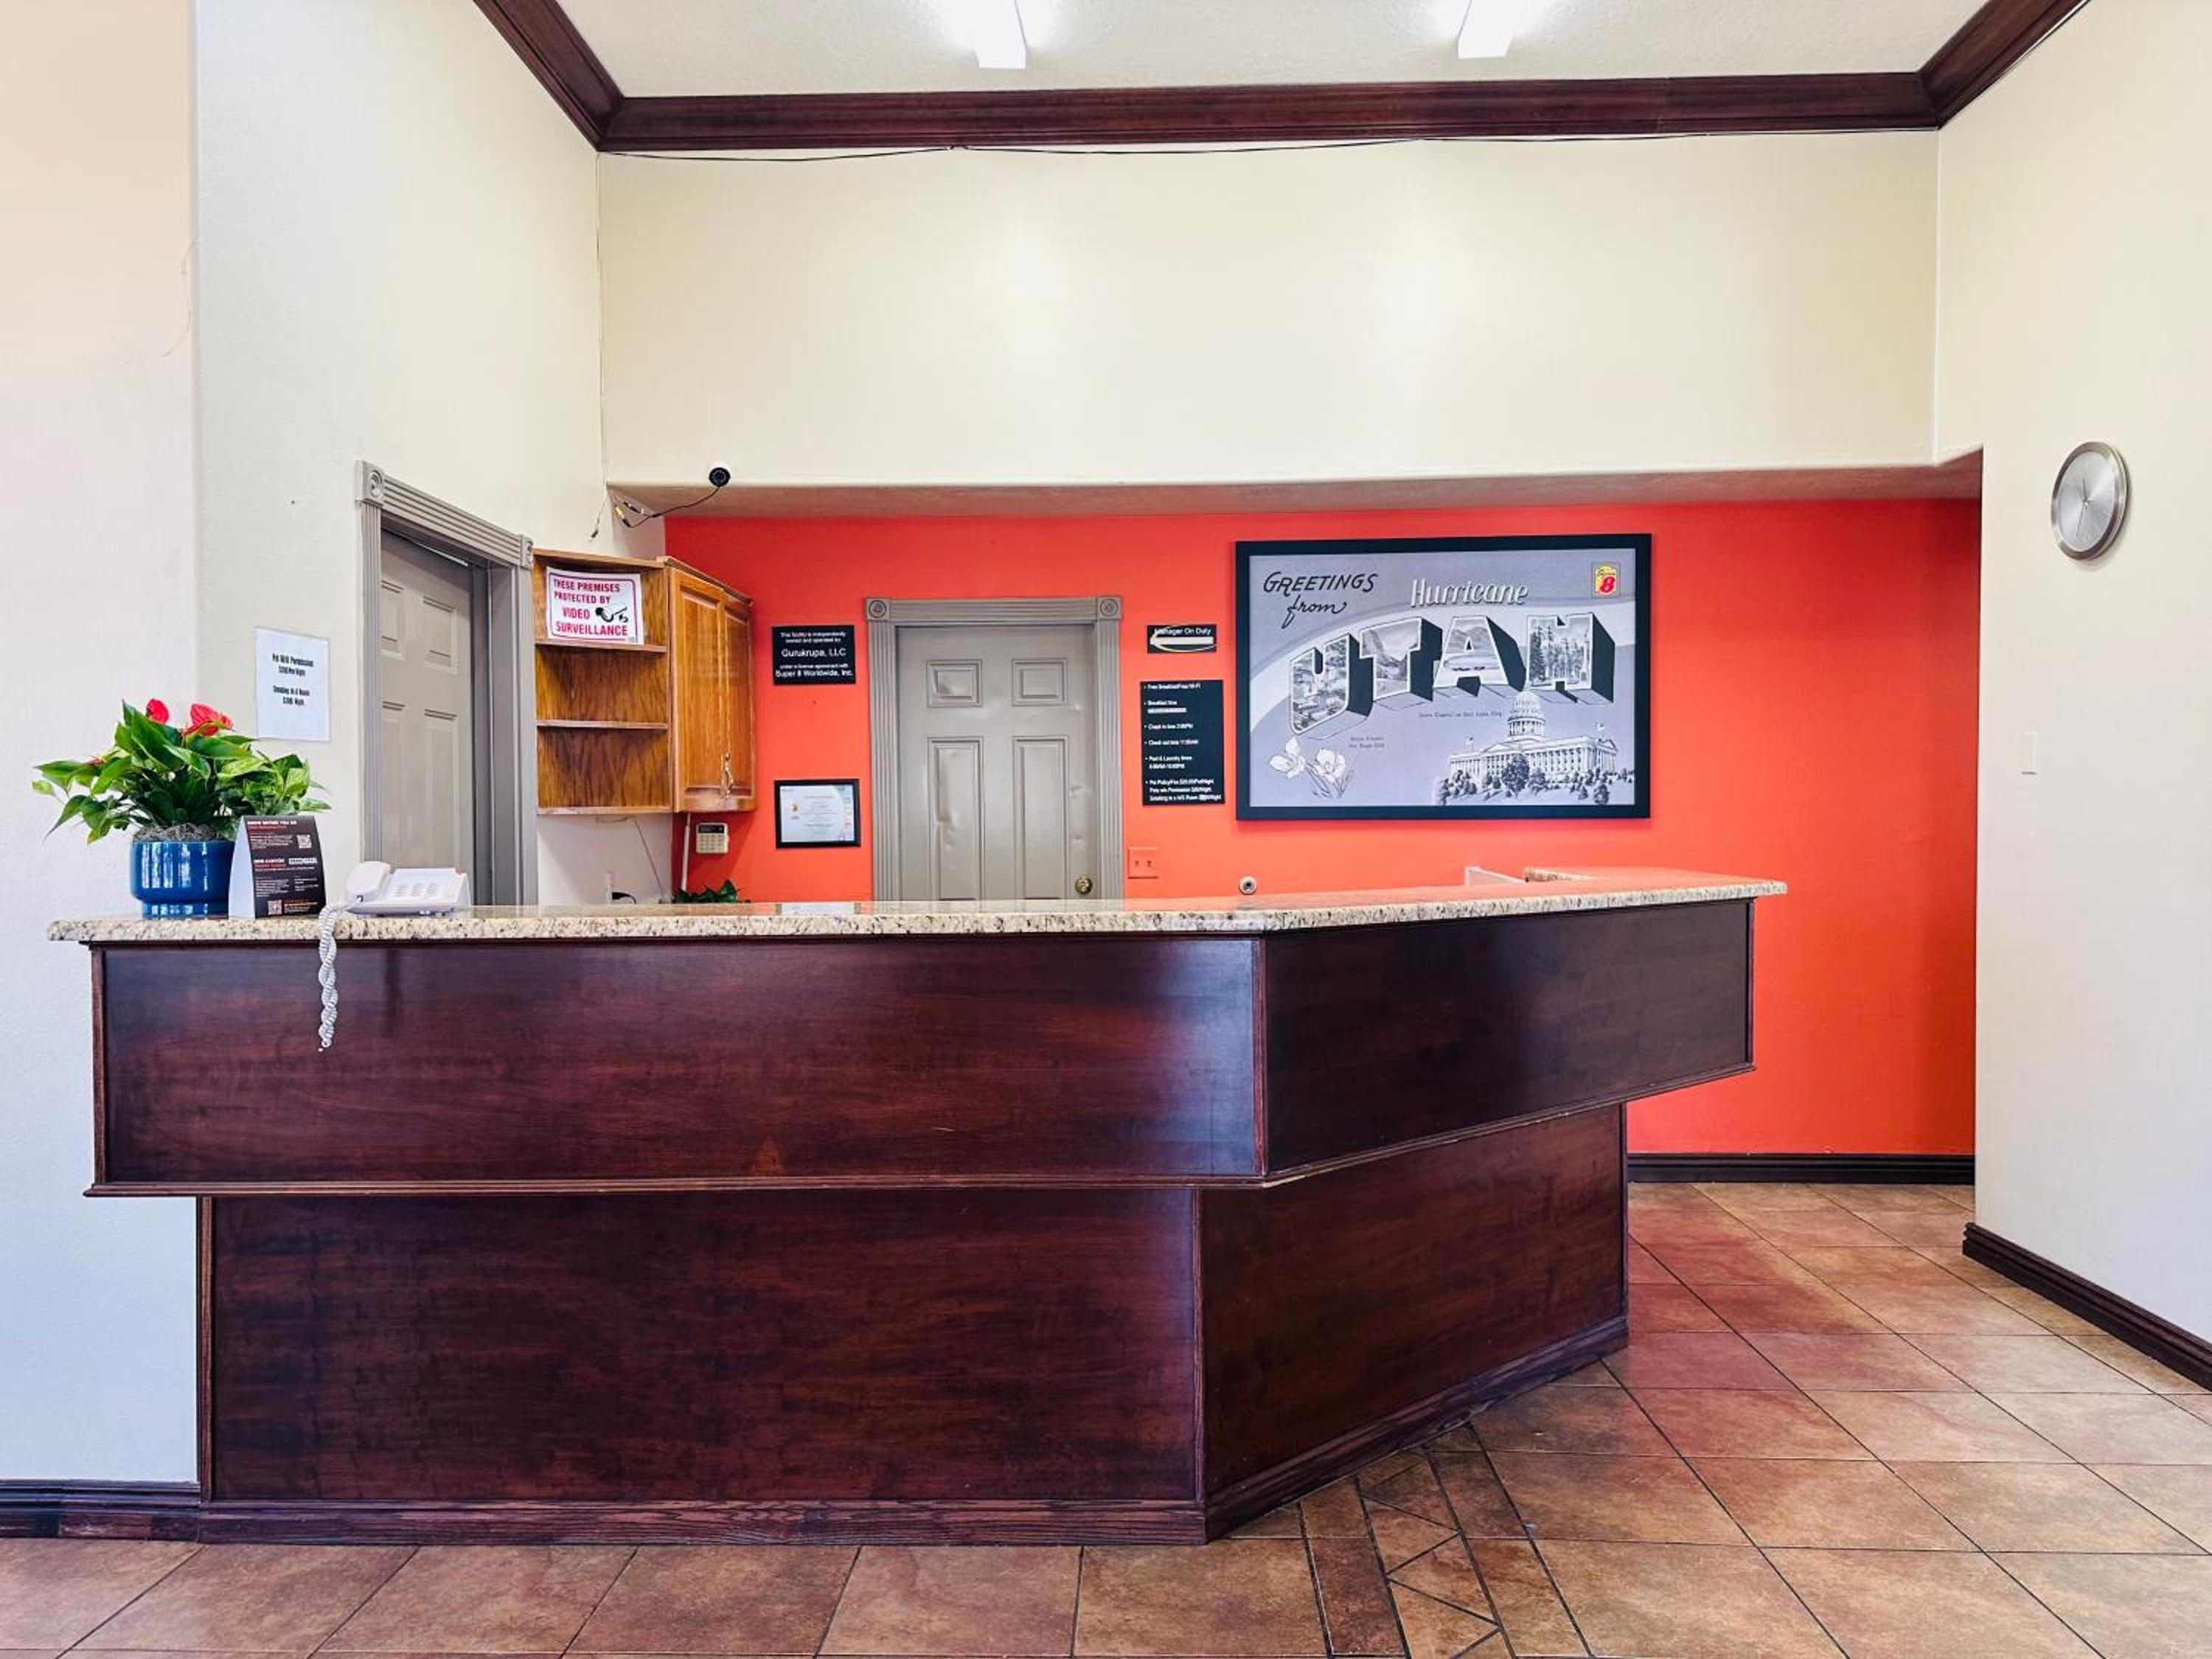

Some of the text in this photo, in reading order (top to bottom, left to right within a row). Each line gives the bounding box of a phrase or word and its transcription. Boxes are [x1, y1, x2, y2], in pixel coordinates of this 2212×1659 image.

[554, 579, 620, 593] THESE PREMISES
[1263, 571, 1378, 597] GREETINGS
[554, 591, 611, 605] PROTECTED BY
[1410, 578, 1528, 608] Hurricane
[563, 607, 590, 620] VIDEO
[1281, 594, 1347, 628] from
[556, 621, 627, 636] SURVEILLANCE
[829, 648, 846, 656] LLC
[1290, 612, 1616, 735] UTAH
